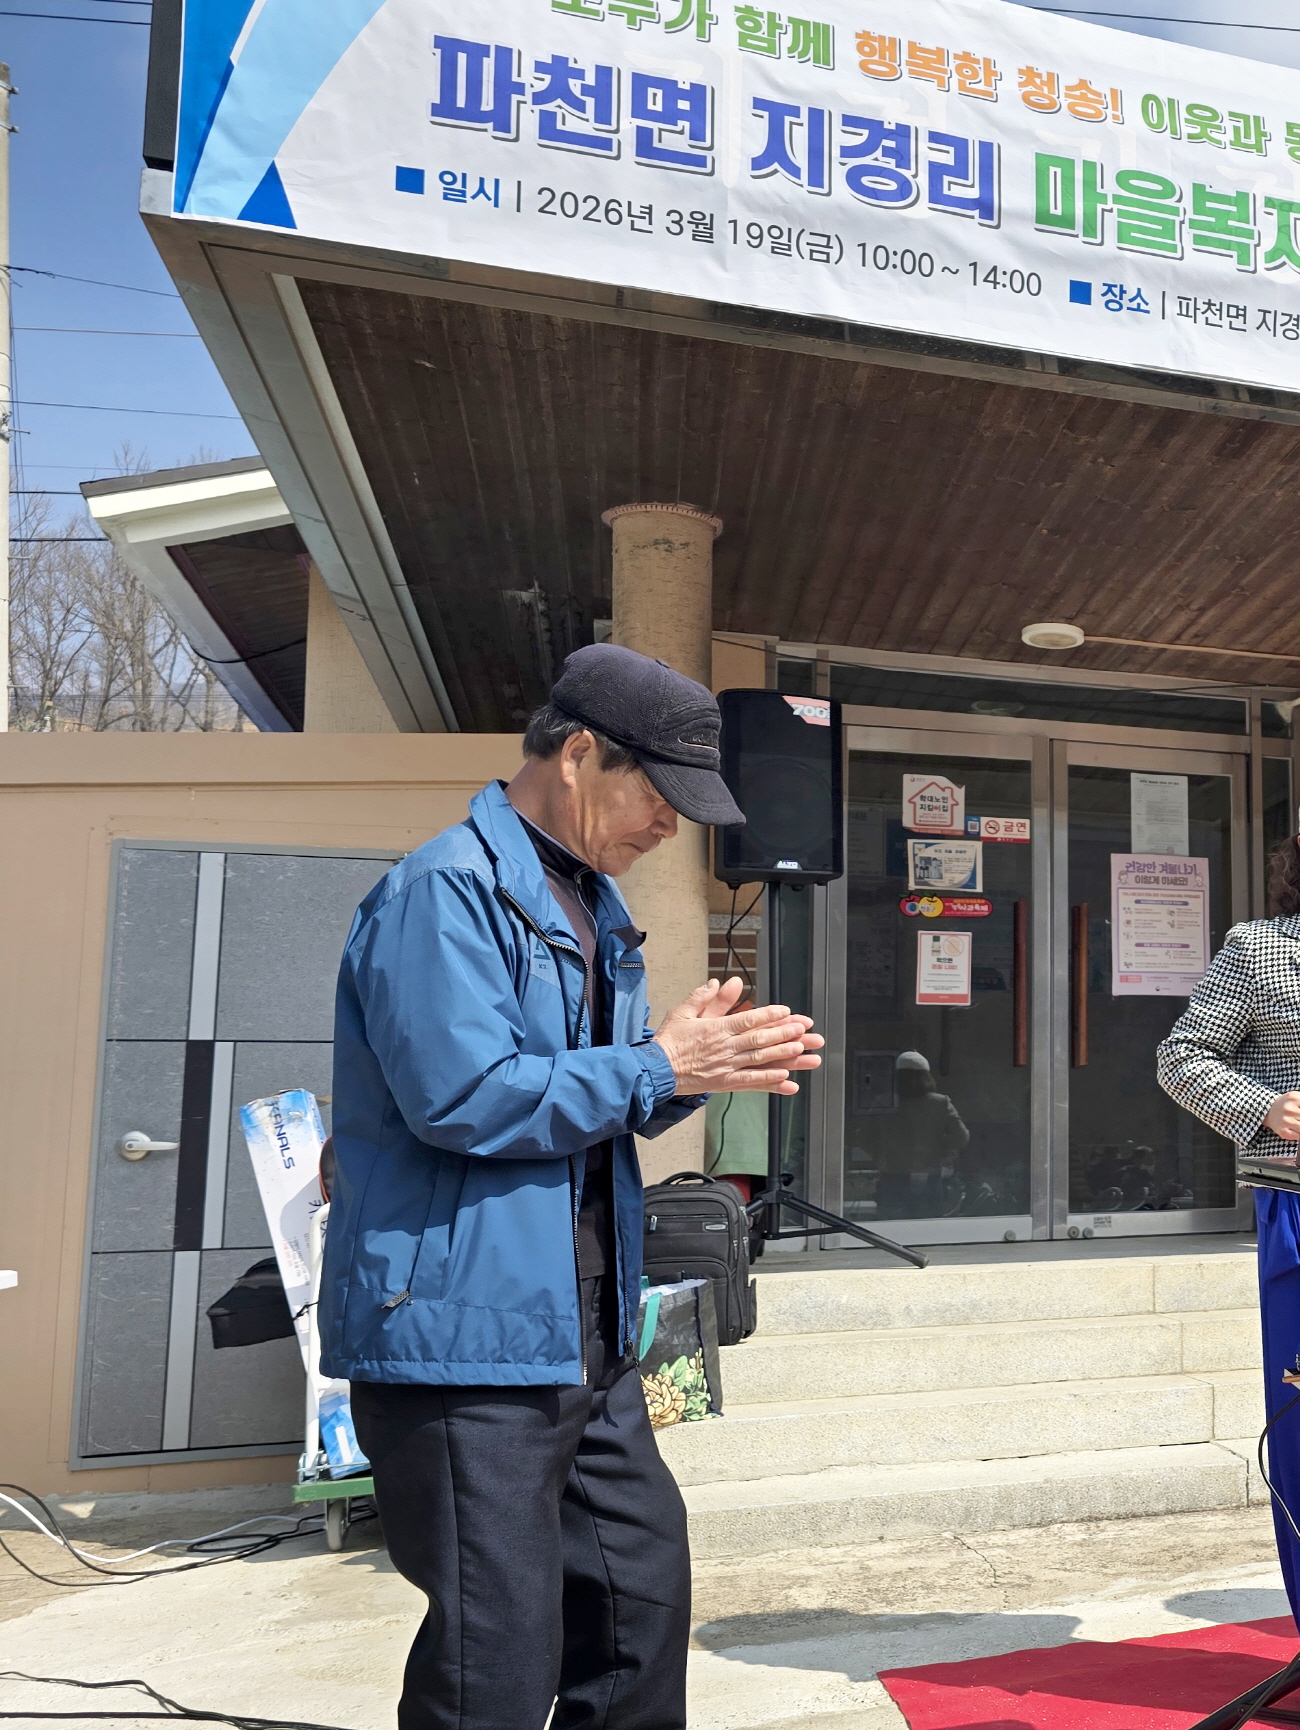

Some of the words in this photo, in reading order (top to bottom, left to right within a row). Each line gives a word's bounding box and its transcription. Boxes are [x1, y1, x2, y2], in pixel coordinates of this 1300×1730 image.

[430, 33, 718, 176] 파천면
[750, 94, 1003, 230] 지경리
[733, 3, 835, 70] 함께
[855, 28, 1003, 101] 행복한
[1018, 64, 1124, 125] 청송!
[1141, 92, 1270, 157] 이웃과
[438, 170, 501, 208] 일시
[537, 187, 655, 235] 2026년
[665, 208, 716, 244] 3월
[727, 219, 846, 267] 19일(금)
[857, 242, 935, 281] 10:00
[967, 261, 1043, 298] 14:00
[1100, 283, 1151, 315] 장소
[1176, 294, 1249, 333] 파천면
[1003, 821, 1027, 833] 금연
